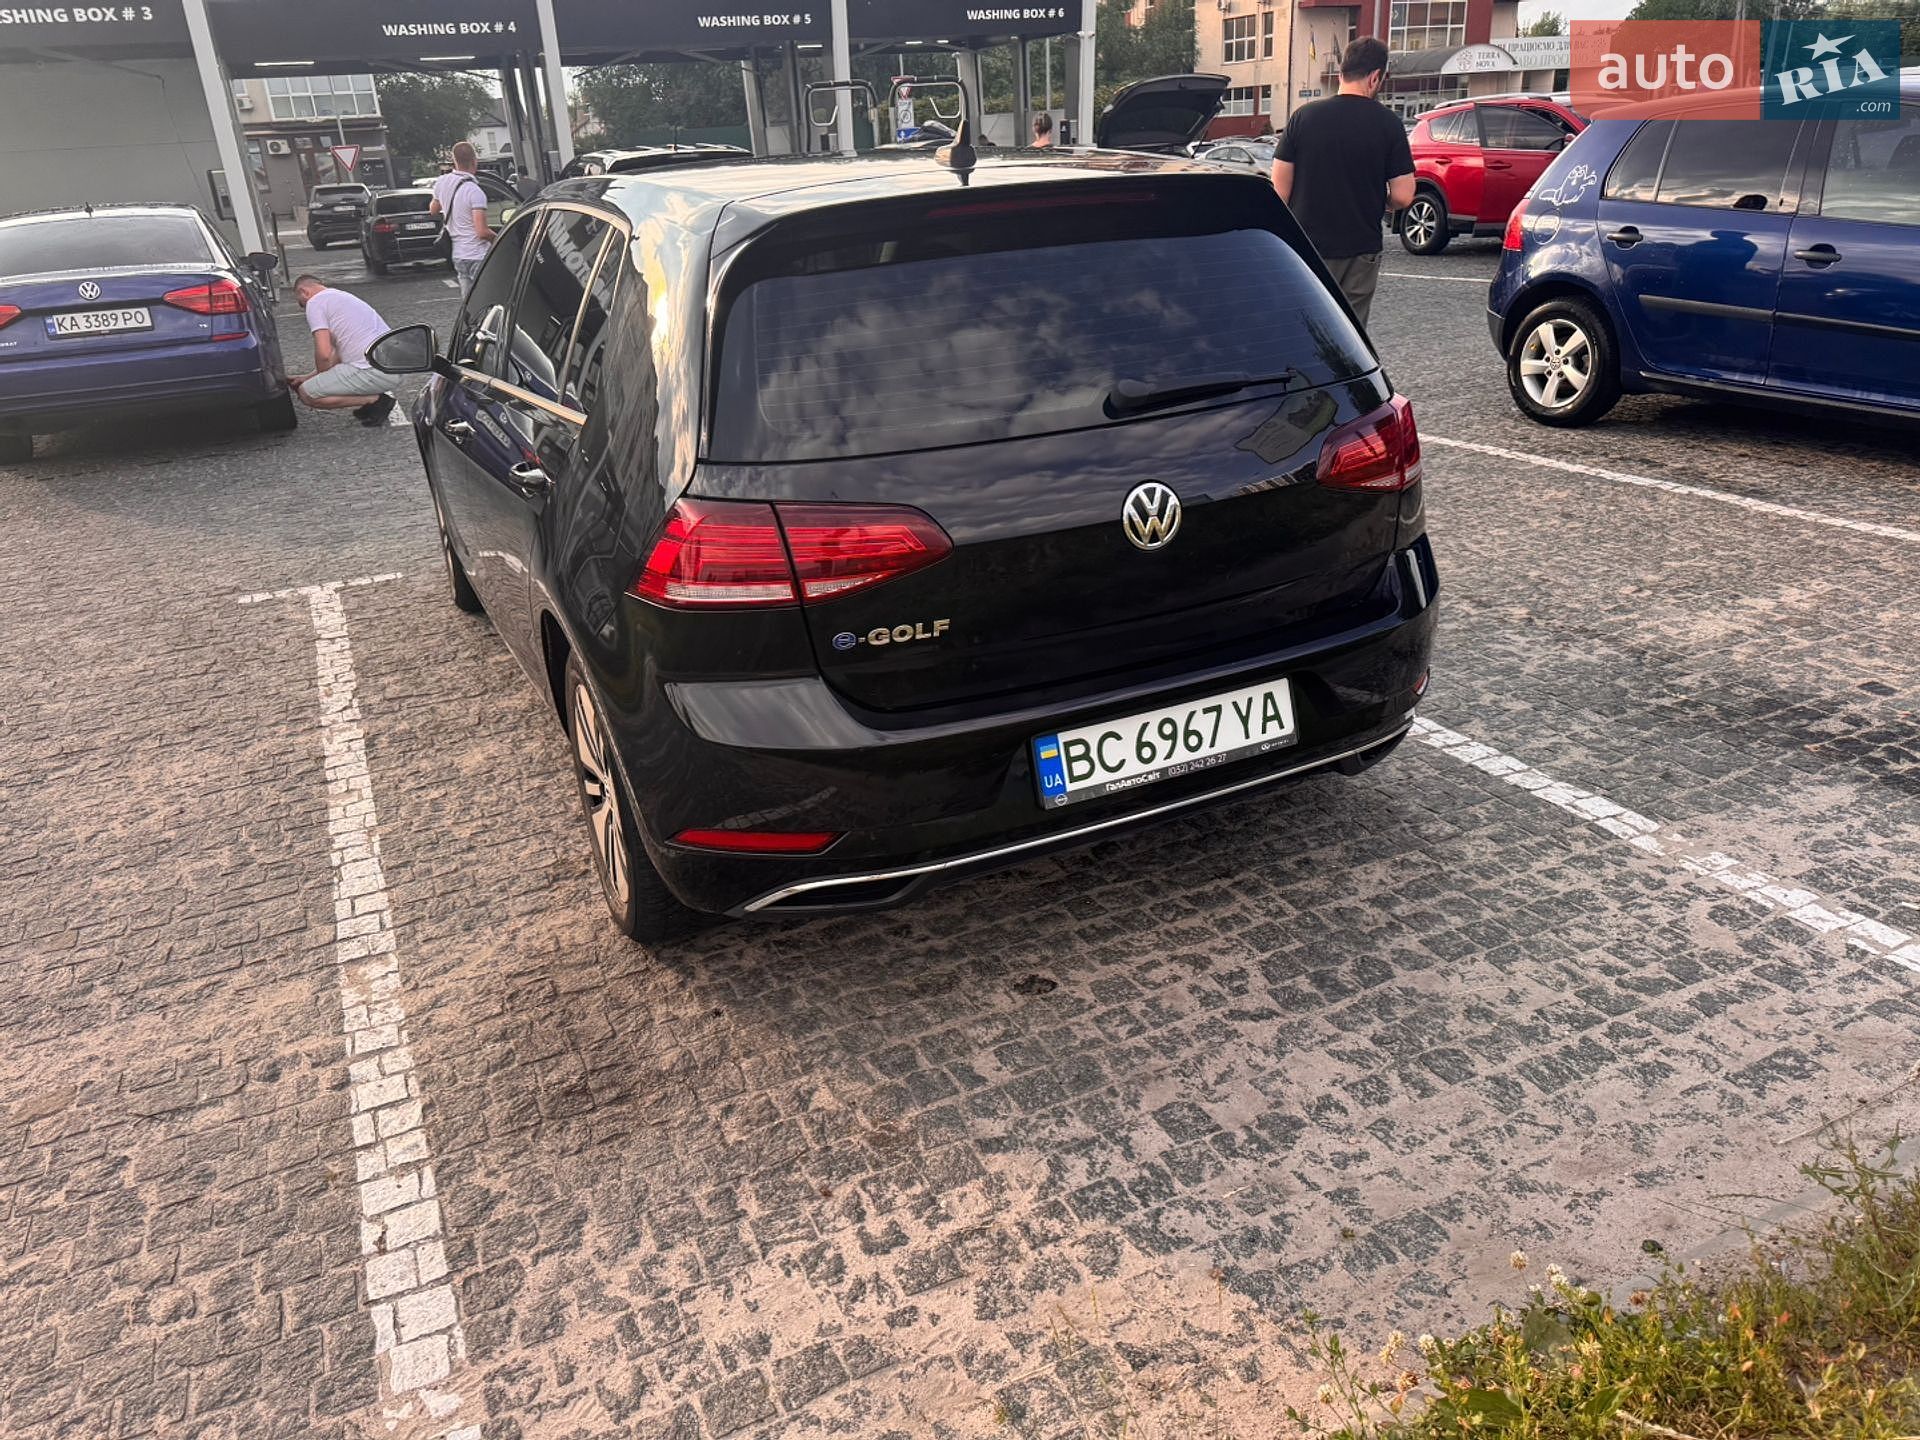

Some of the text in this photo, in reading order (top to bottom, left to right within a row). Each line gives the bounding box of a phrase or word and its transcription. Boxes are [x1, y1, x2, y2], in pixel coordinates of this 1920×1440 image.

[0, 6, 153, 24] SHING BOX # 3
[697, 13, 812, 27] WASHING BOX # 5
[966, 7, 1065, 20] WASHING BOX # 6
[382, 21, 516, 36] WASHING BOX # 4
[1477, 51, 1500, 60] TERRA
[1475, 60, 1496, 68] NOVA
[56, 310, 145, 332] KA 3389 PO
[832, 618, 951, 650] e-GOLF
[1062, 691, 1285, 784] BC 6967 YA
[1189, 759, 1204, 771] 242
[1206, 756, 1216, 767] 26
[1217, 753, 1227, 764] 27
[1044, 773, 1063, 788] UA
